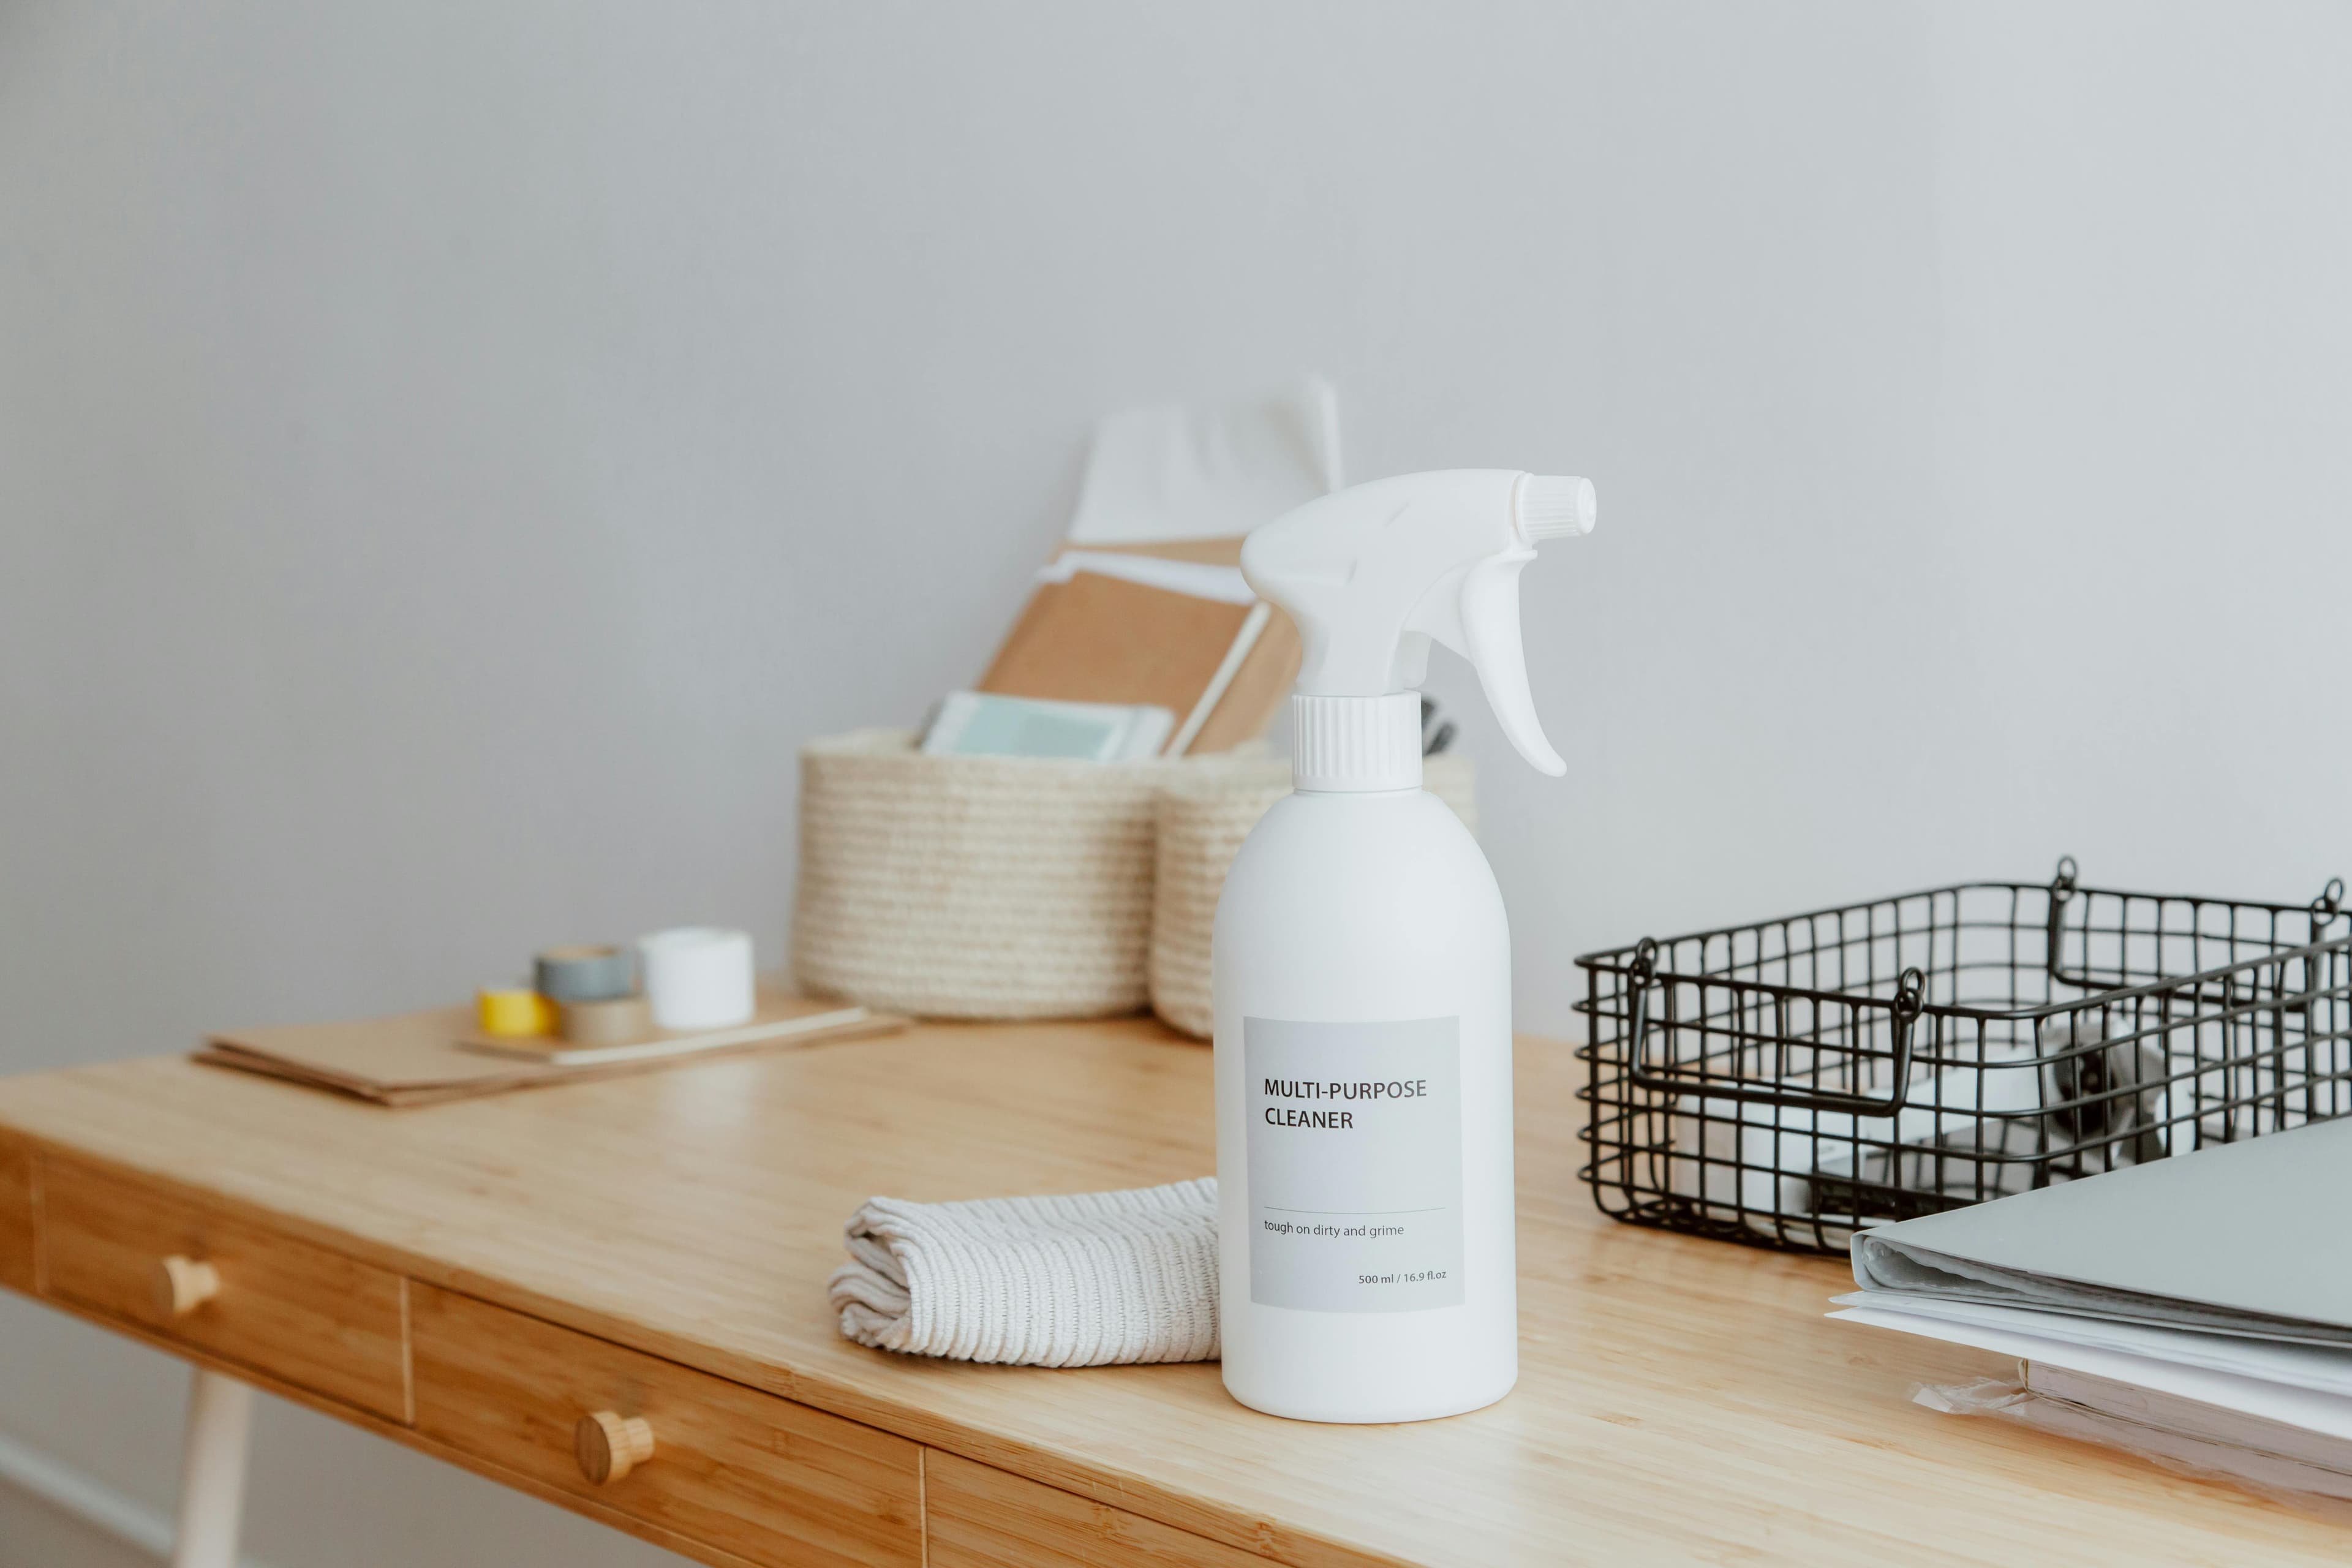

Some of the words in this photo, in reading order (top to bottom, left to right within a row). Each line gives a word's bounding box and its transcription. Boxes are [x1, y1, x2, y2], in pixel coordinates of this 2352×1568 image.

[1264, 1078, 1427, 1100] MULTI-PURPOSE
[1265, 1107, 1354, 1129] CLEANER
[1264, 1219, 1294, 1235] tough
[1296, 1226, 1310, 1235] on
[1313, 1224, 1341, 1238] dirty
[1343, 1224, 1366, 1237] and
[1369, 1225, 1404, 1239] grime
[1358, 1275, 1379, 1284] 500
[1381, 1273, 1394, 1284] ml
[1396, 1273, 1401, 1284] /
[1404, 1272, 1425, 1283] 16.9
[1427, 1270, 1447, 1281] fl.oz
